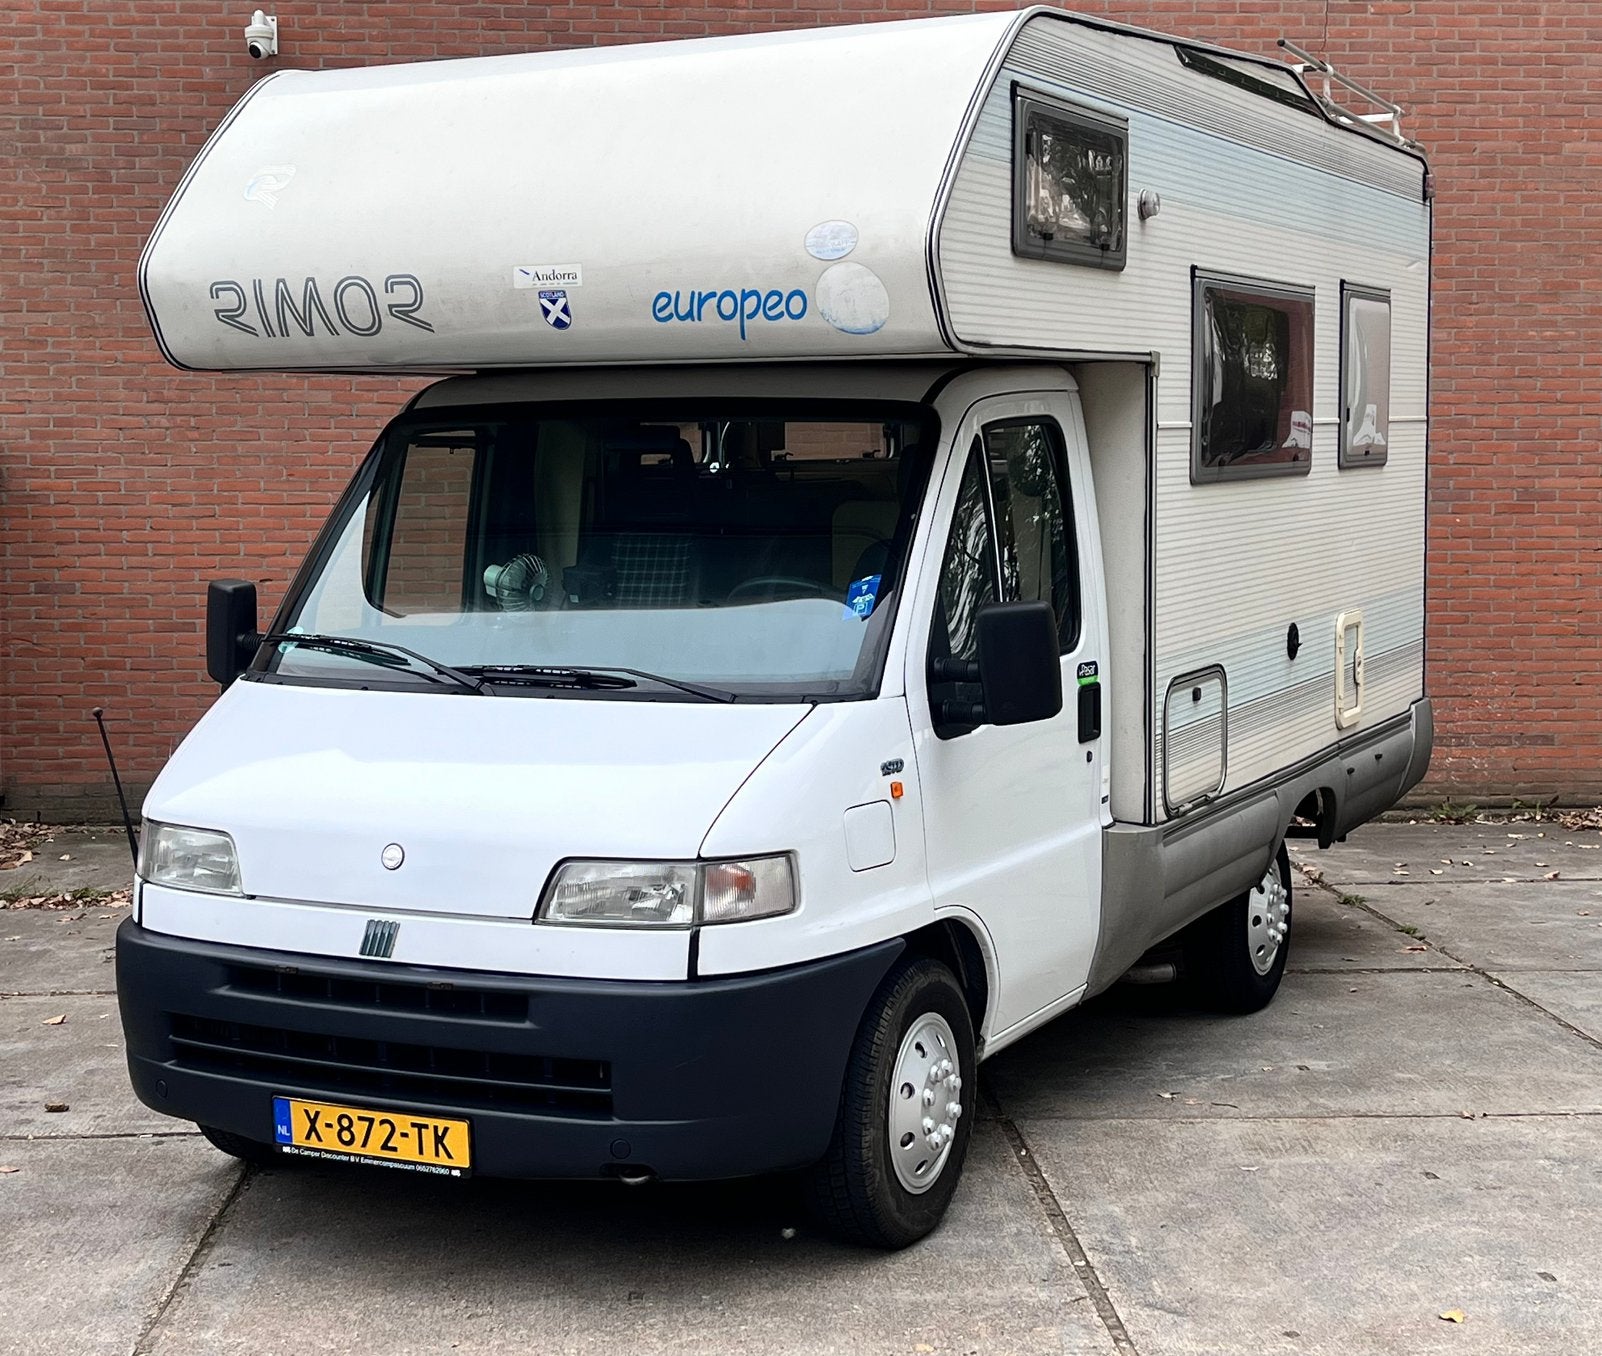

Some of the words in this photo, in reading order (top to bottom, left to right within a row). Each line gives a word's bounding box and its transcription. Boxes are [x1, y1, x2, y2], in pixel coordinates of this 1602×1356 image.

[532, 269, 578, 281] Andorra
[209, 273, 435, 338] RIMOR
[652, 288, 808, 341] europeo
[277, 1124, 291, 1136] NL
[303, 1108, 455, 1160] X-872-TK
[299, 1148, 320, 1158] Camper
